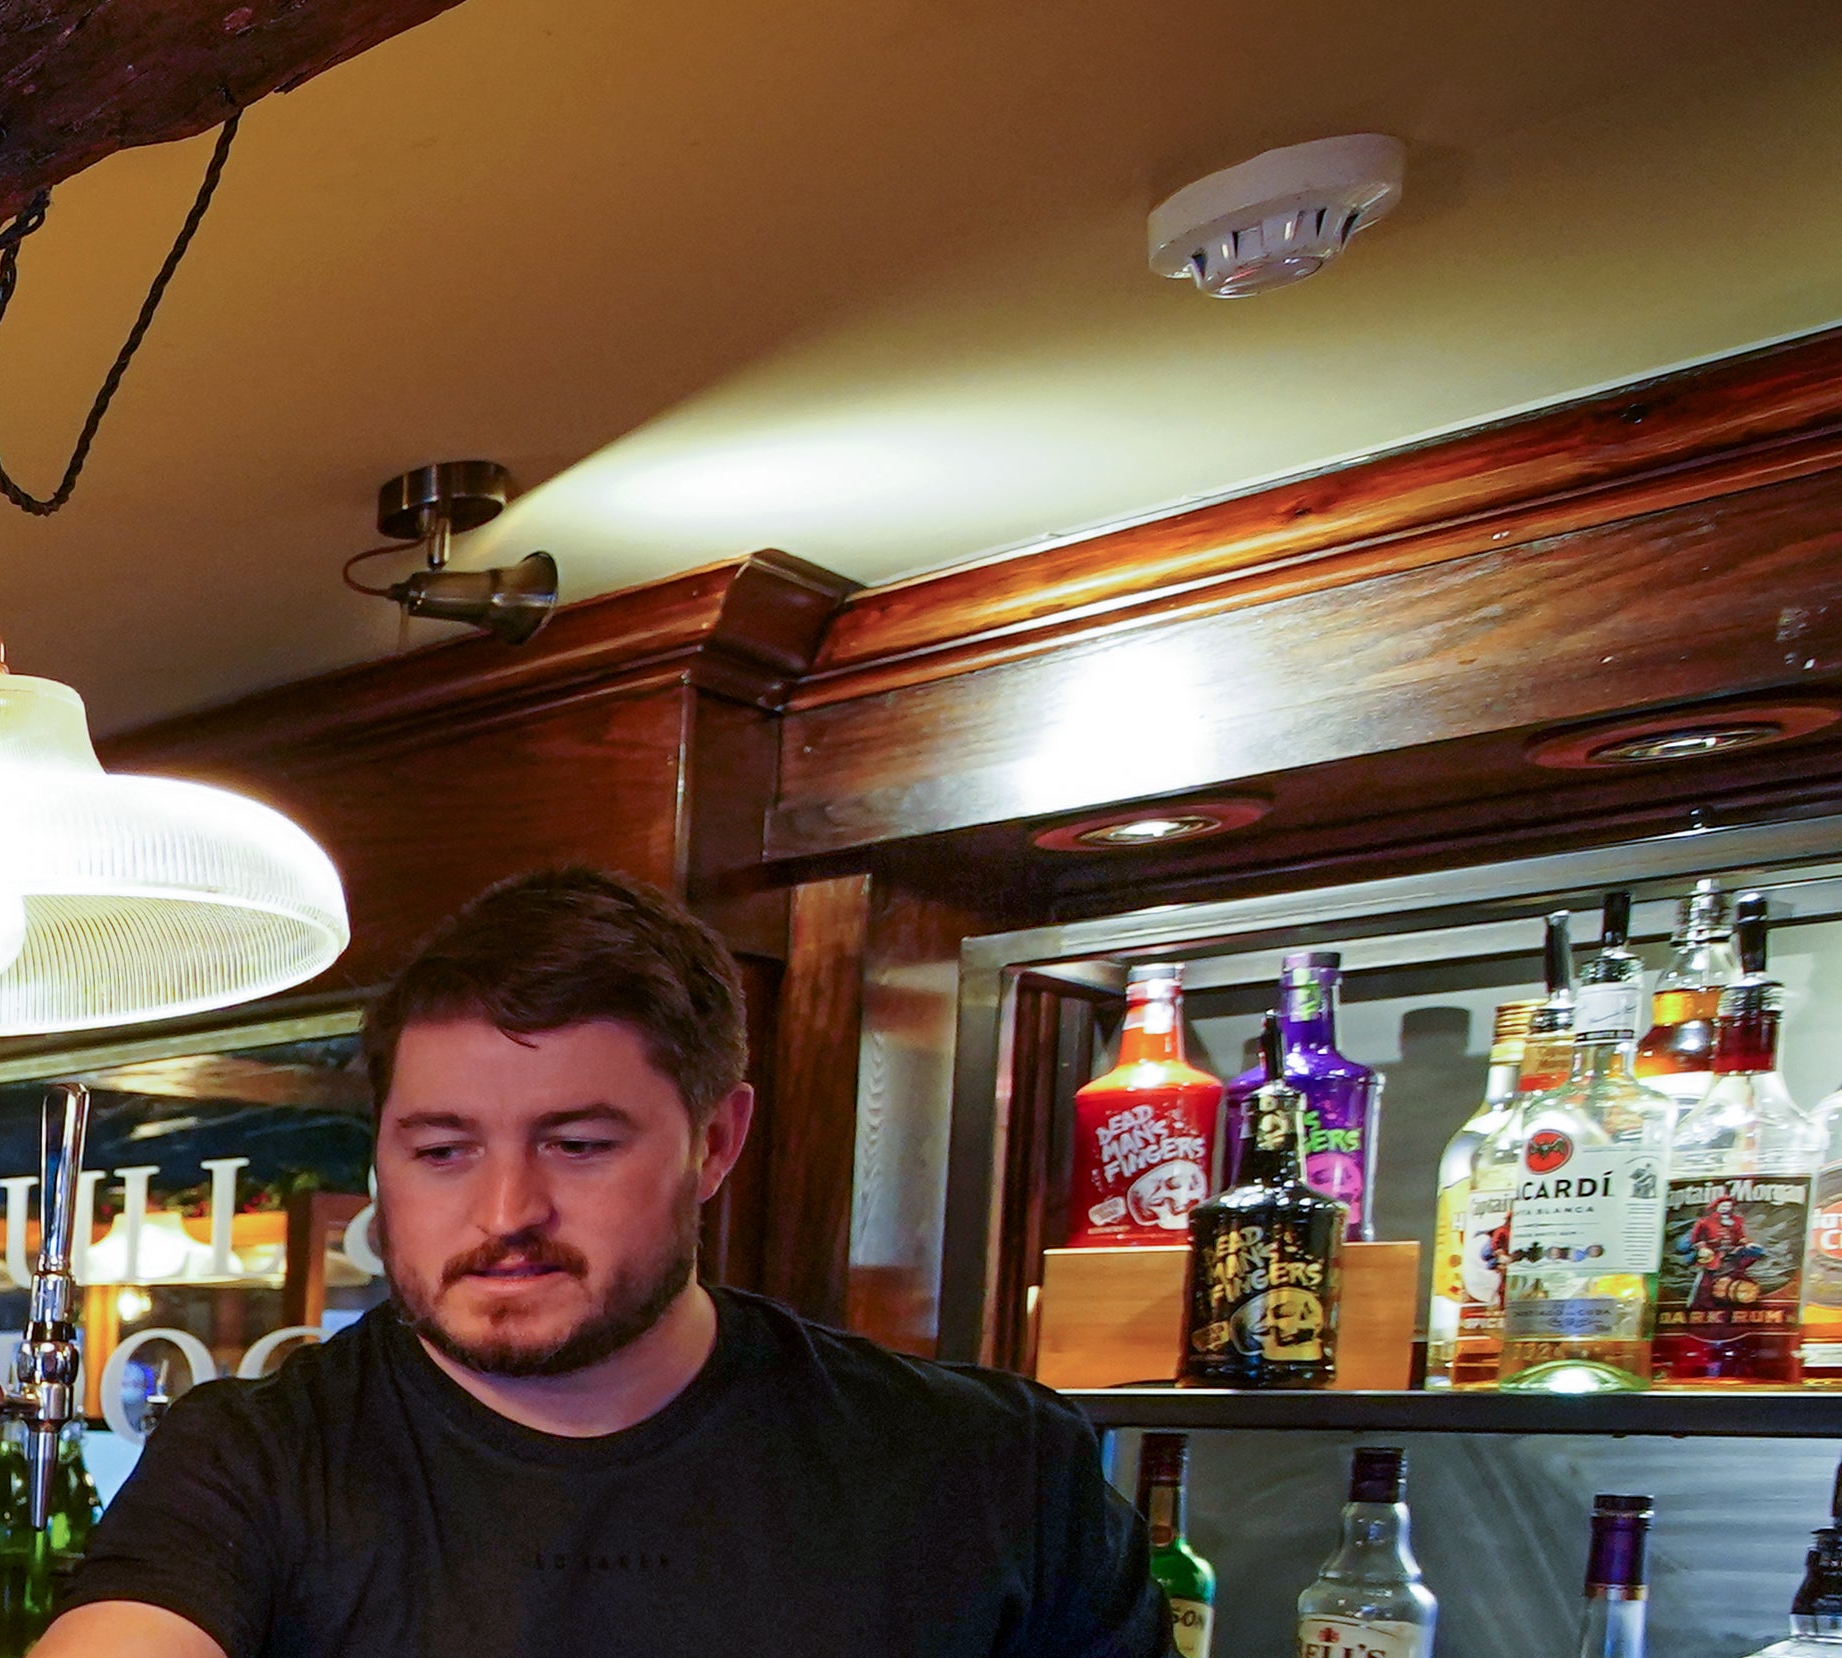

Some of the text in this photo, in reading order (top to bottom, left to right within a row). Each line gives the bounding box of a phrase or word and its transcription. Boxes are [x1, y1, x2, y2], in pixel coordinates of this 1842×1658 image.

[1095, 1105, 1154, 1146] DEAD
[1103, 1136, 1207, 1184] FINGERS
[1516, 1170, 1615, 1201] CARDÍ
[1725, 1179, 1808, 1206] Morgan
[1210, 1262, 1325, 1311] FINGERS
